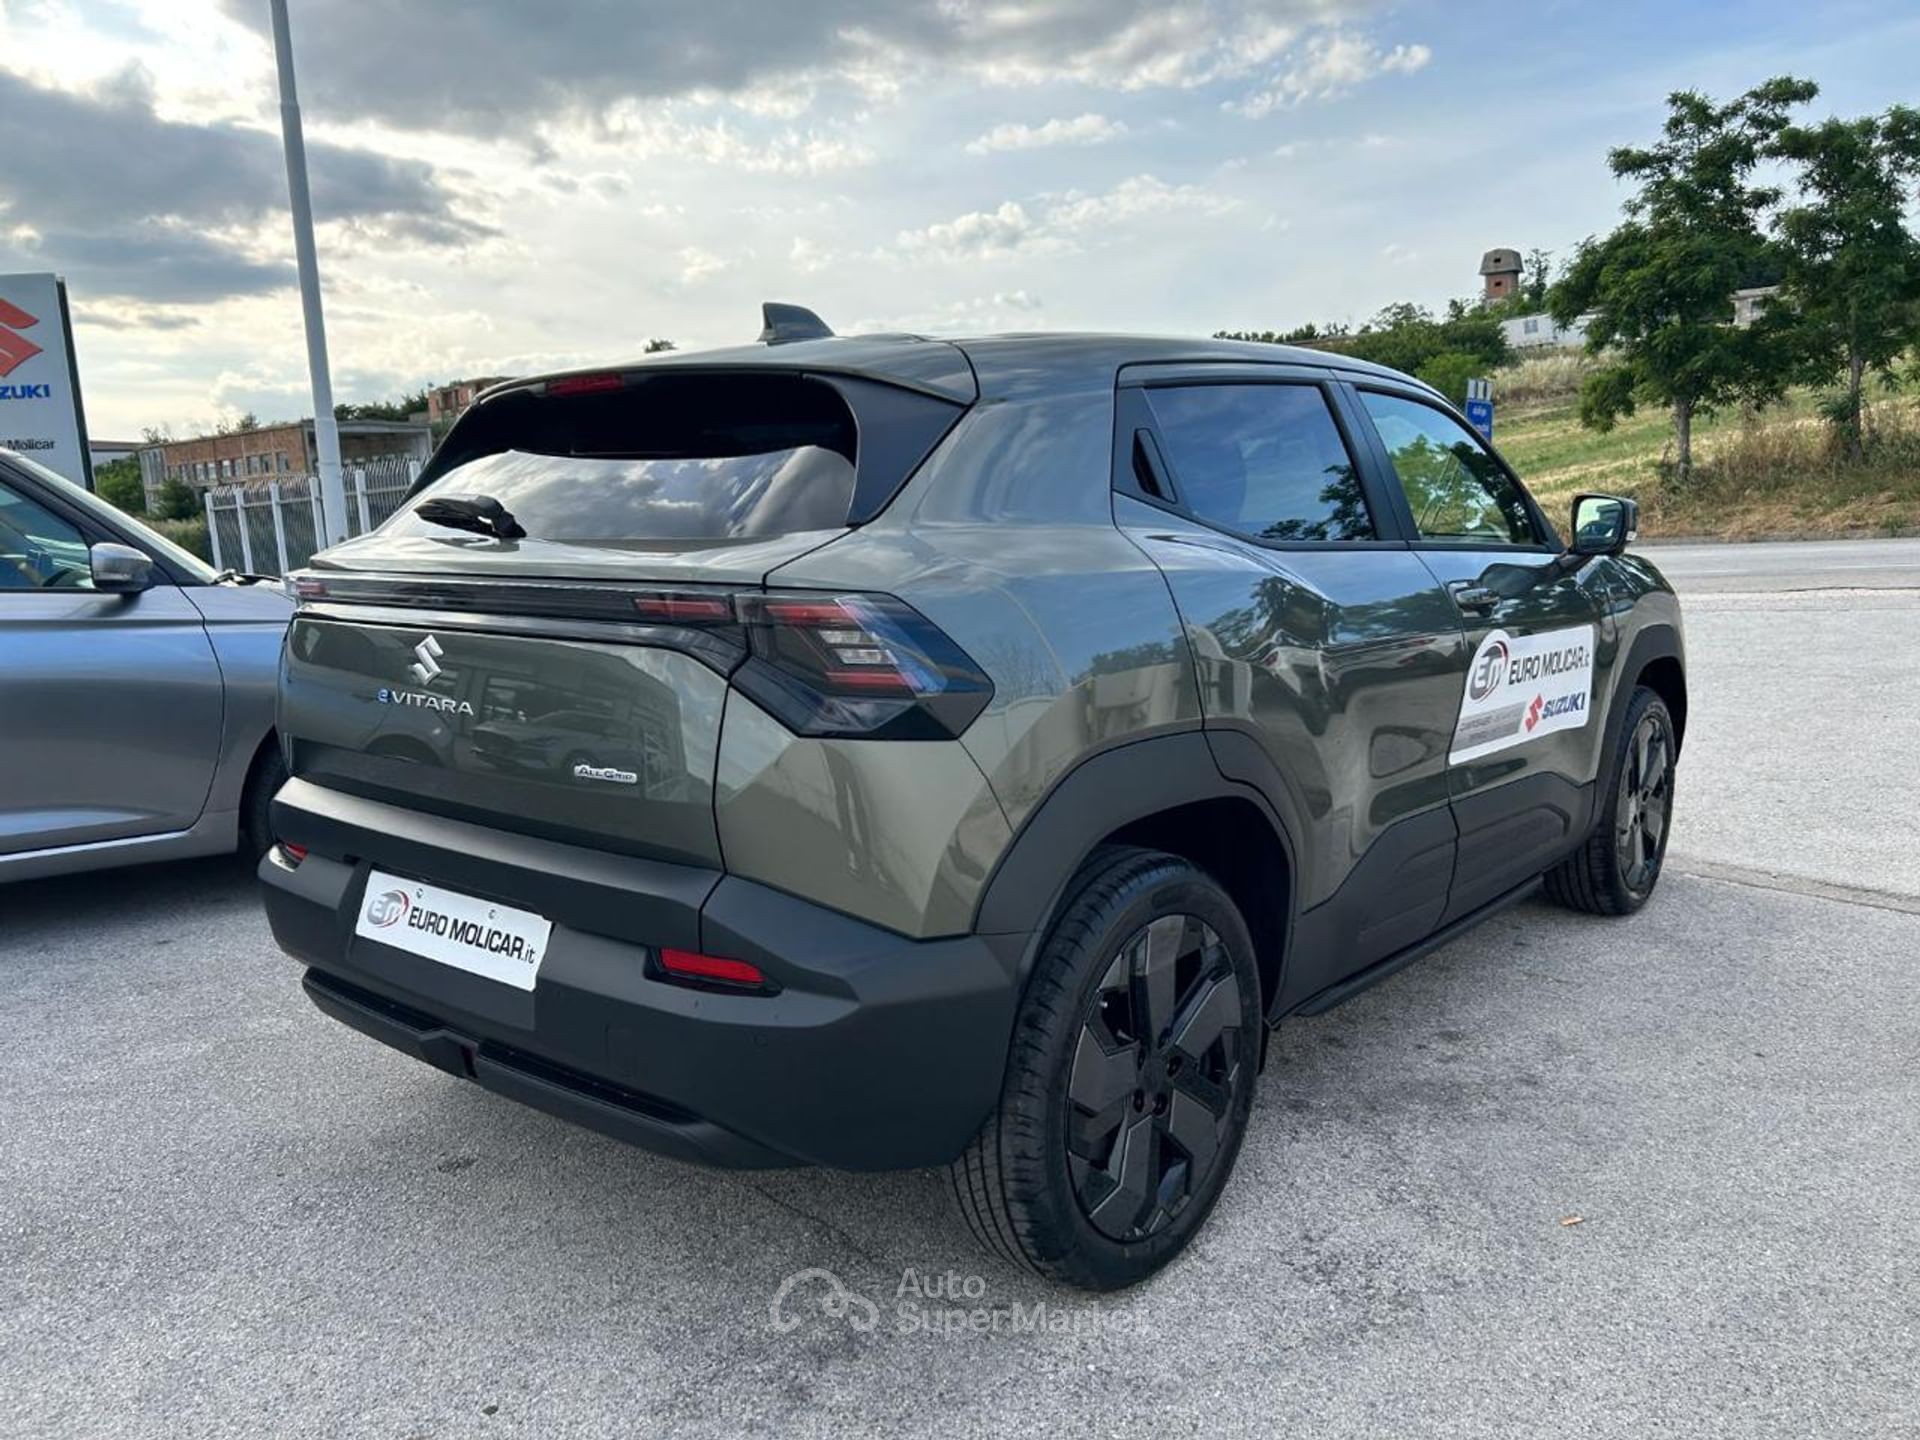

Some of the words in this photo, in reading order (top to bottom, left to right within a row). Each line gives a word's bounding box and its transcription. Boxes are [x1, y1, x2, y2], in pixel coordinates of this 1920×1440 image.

[7, 439, 55, 451] Molicar
[1509, 655, 1540, 685] EURO
[1542, 692, 1586, 719] SUZUKI
[407, 905, 449, 936] EURO
[449, 918, 536, 965] MOLICAR.it
